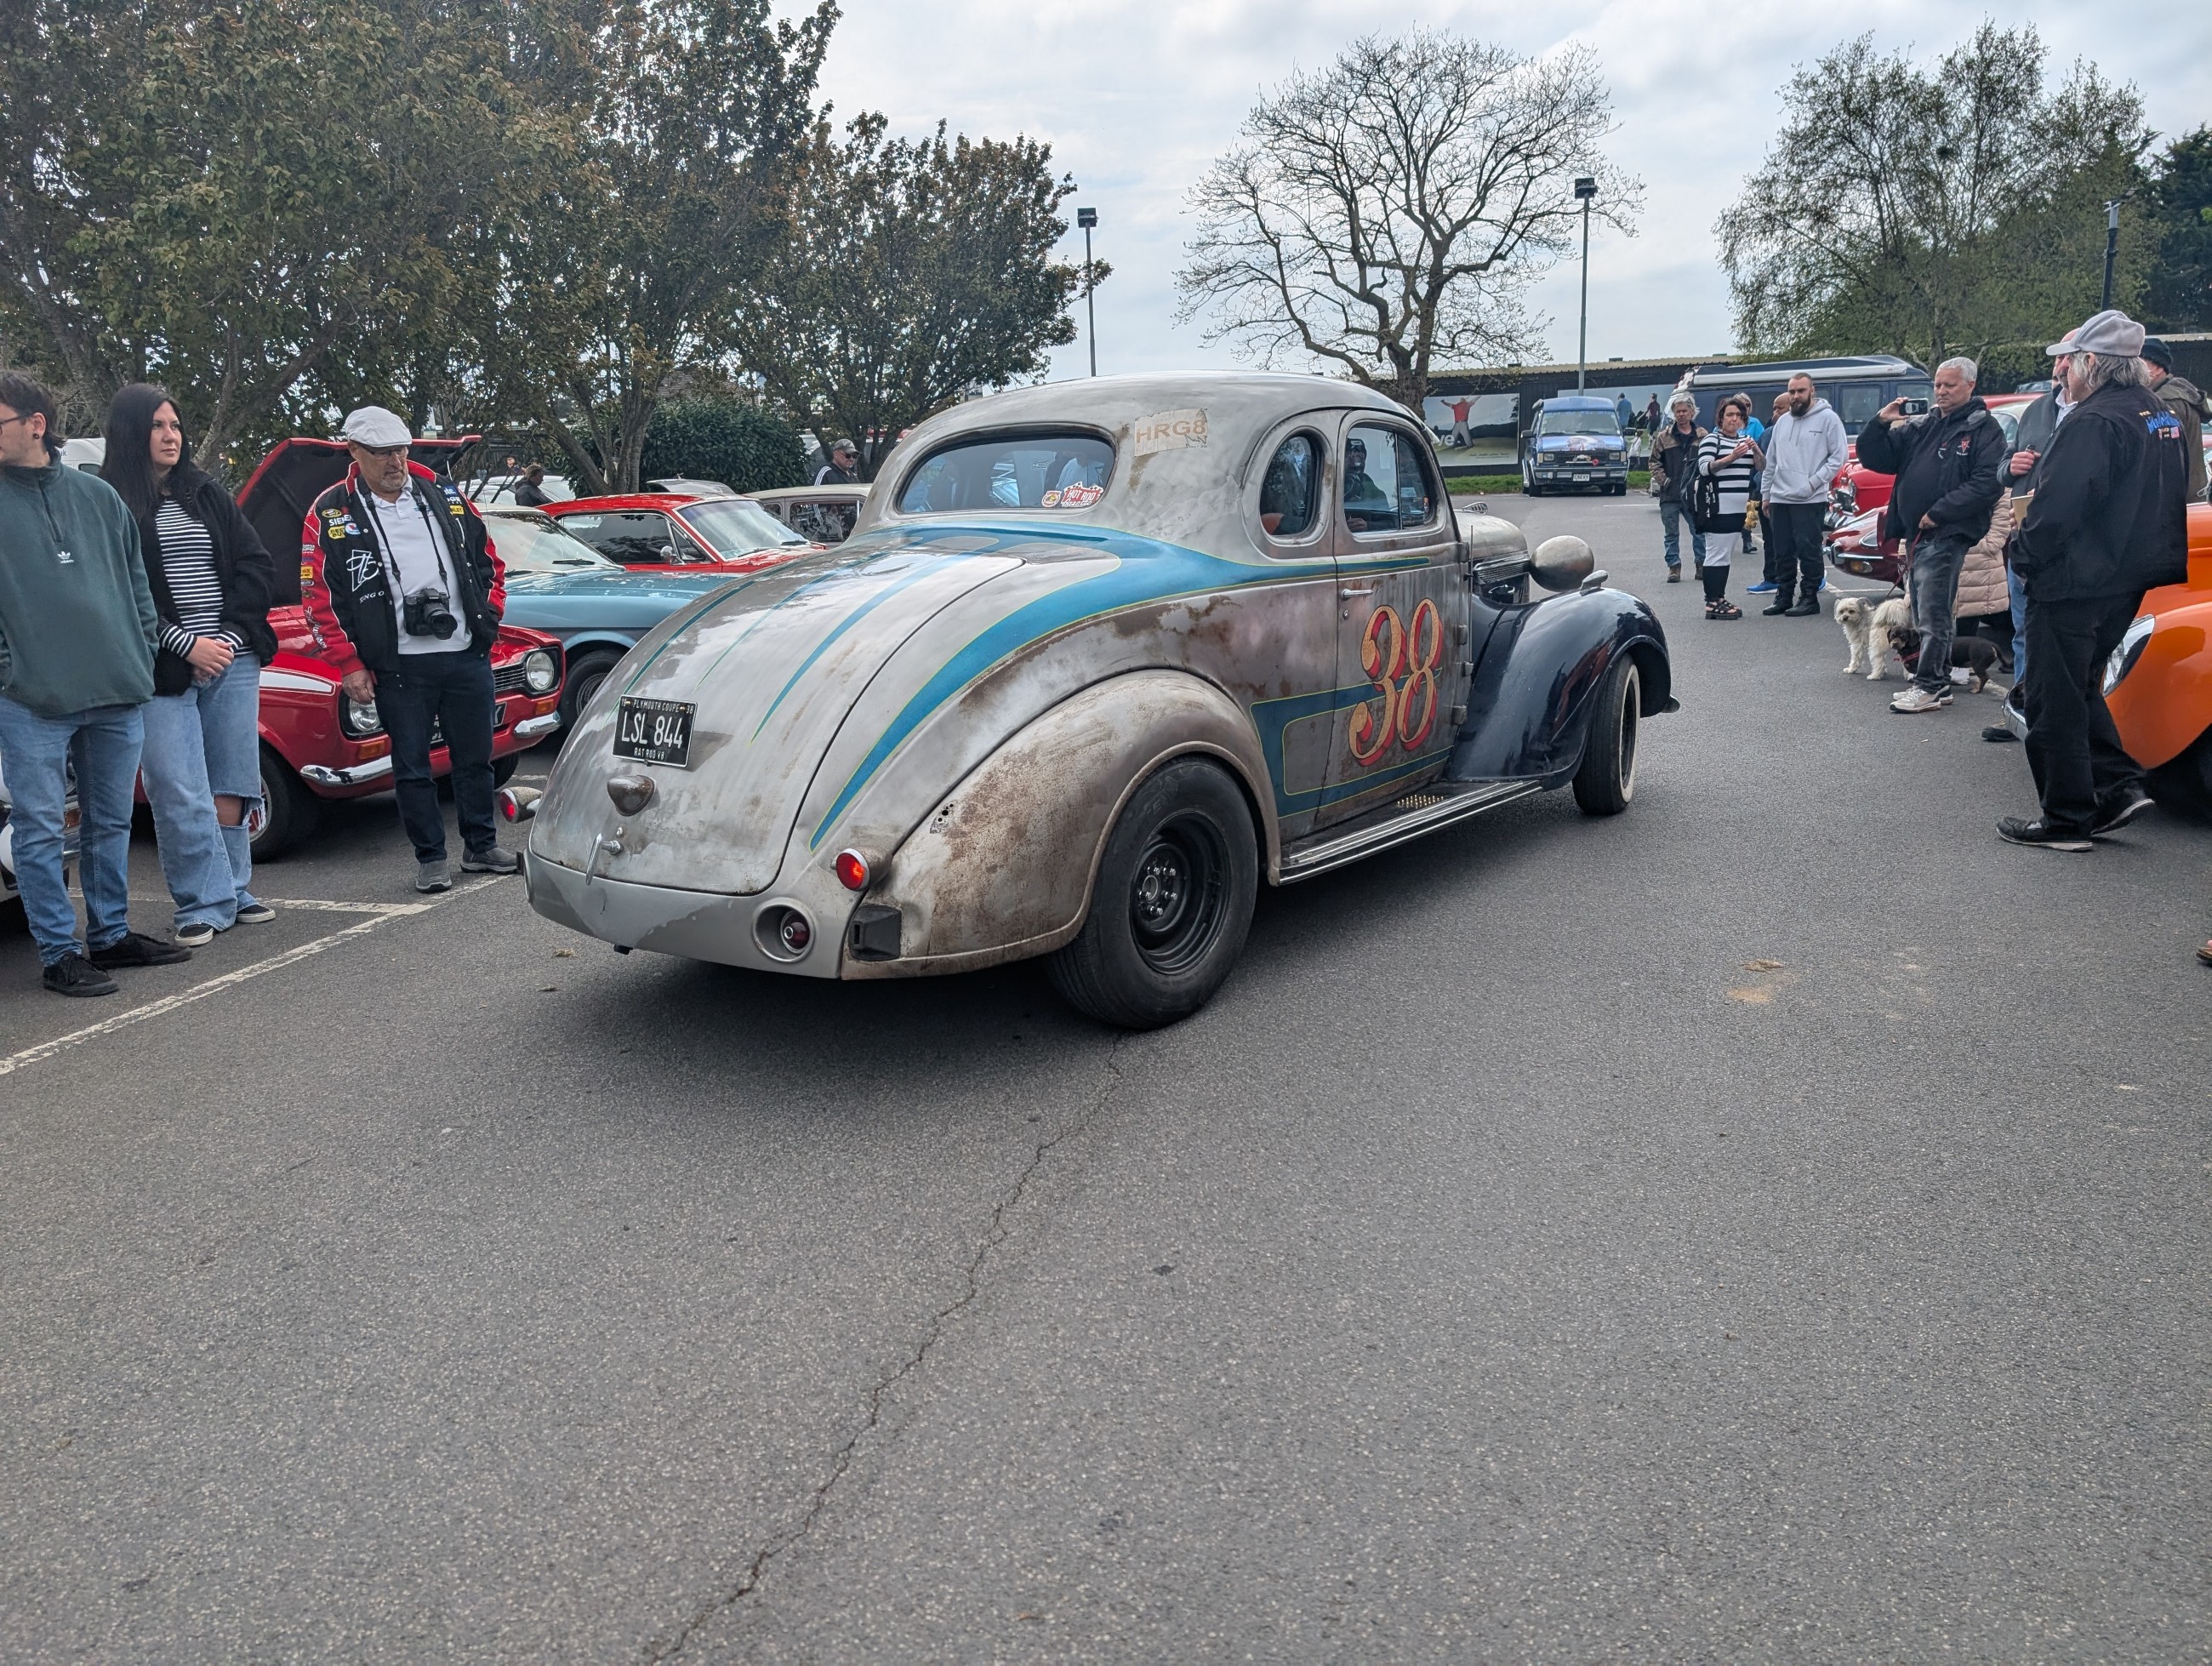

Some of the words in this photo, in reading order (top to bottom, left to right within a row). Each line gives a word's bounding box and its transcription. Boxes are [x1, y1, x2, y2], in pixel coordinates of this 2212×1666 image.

[1136, 419, 1206, 443] HRG8
[1067, 489, 1083, 499] HOT
[1080, 492, 1097, 502] ROD
[1348, 597, 1443, 767] 38
[632, 699, 661, 710] PLYMOUTH
[662, 702, 680, 713] COUPE
[686, 705, 694, 715] 38
[621, 710, 648, 745] LSL
[653, 715, 683, 749] 844
[634, 747, 645, 757] RAT
[646, 749, 656, 759] ROD
